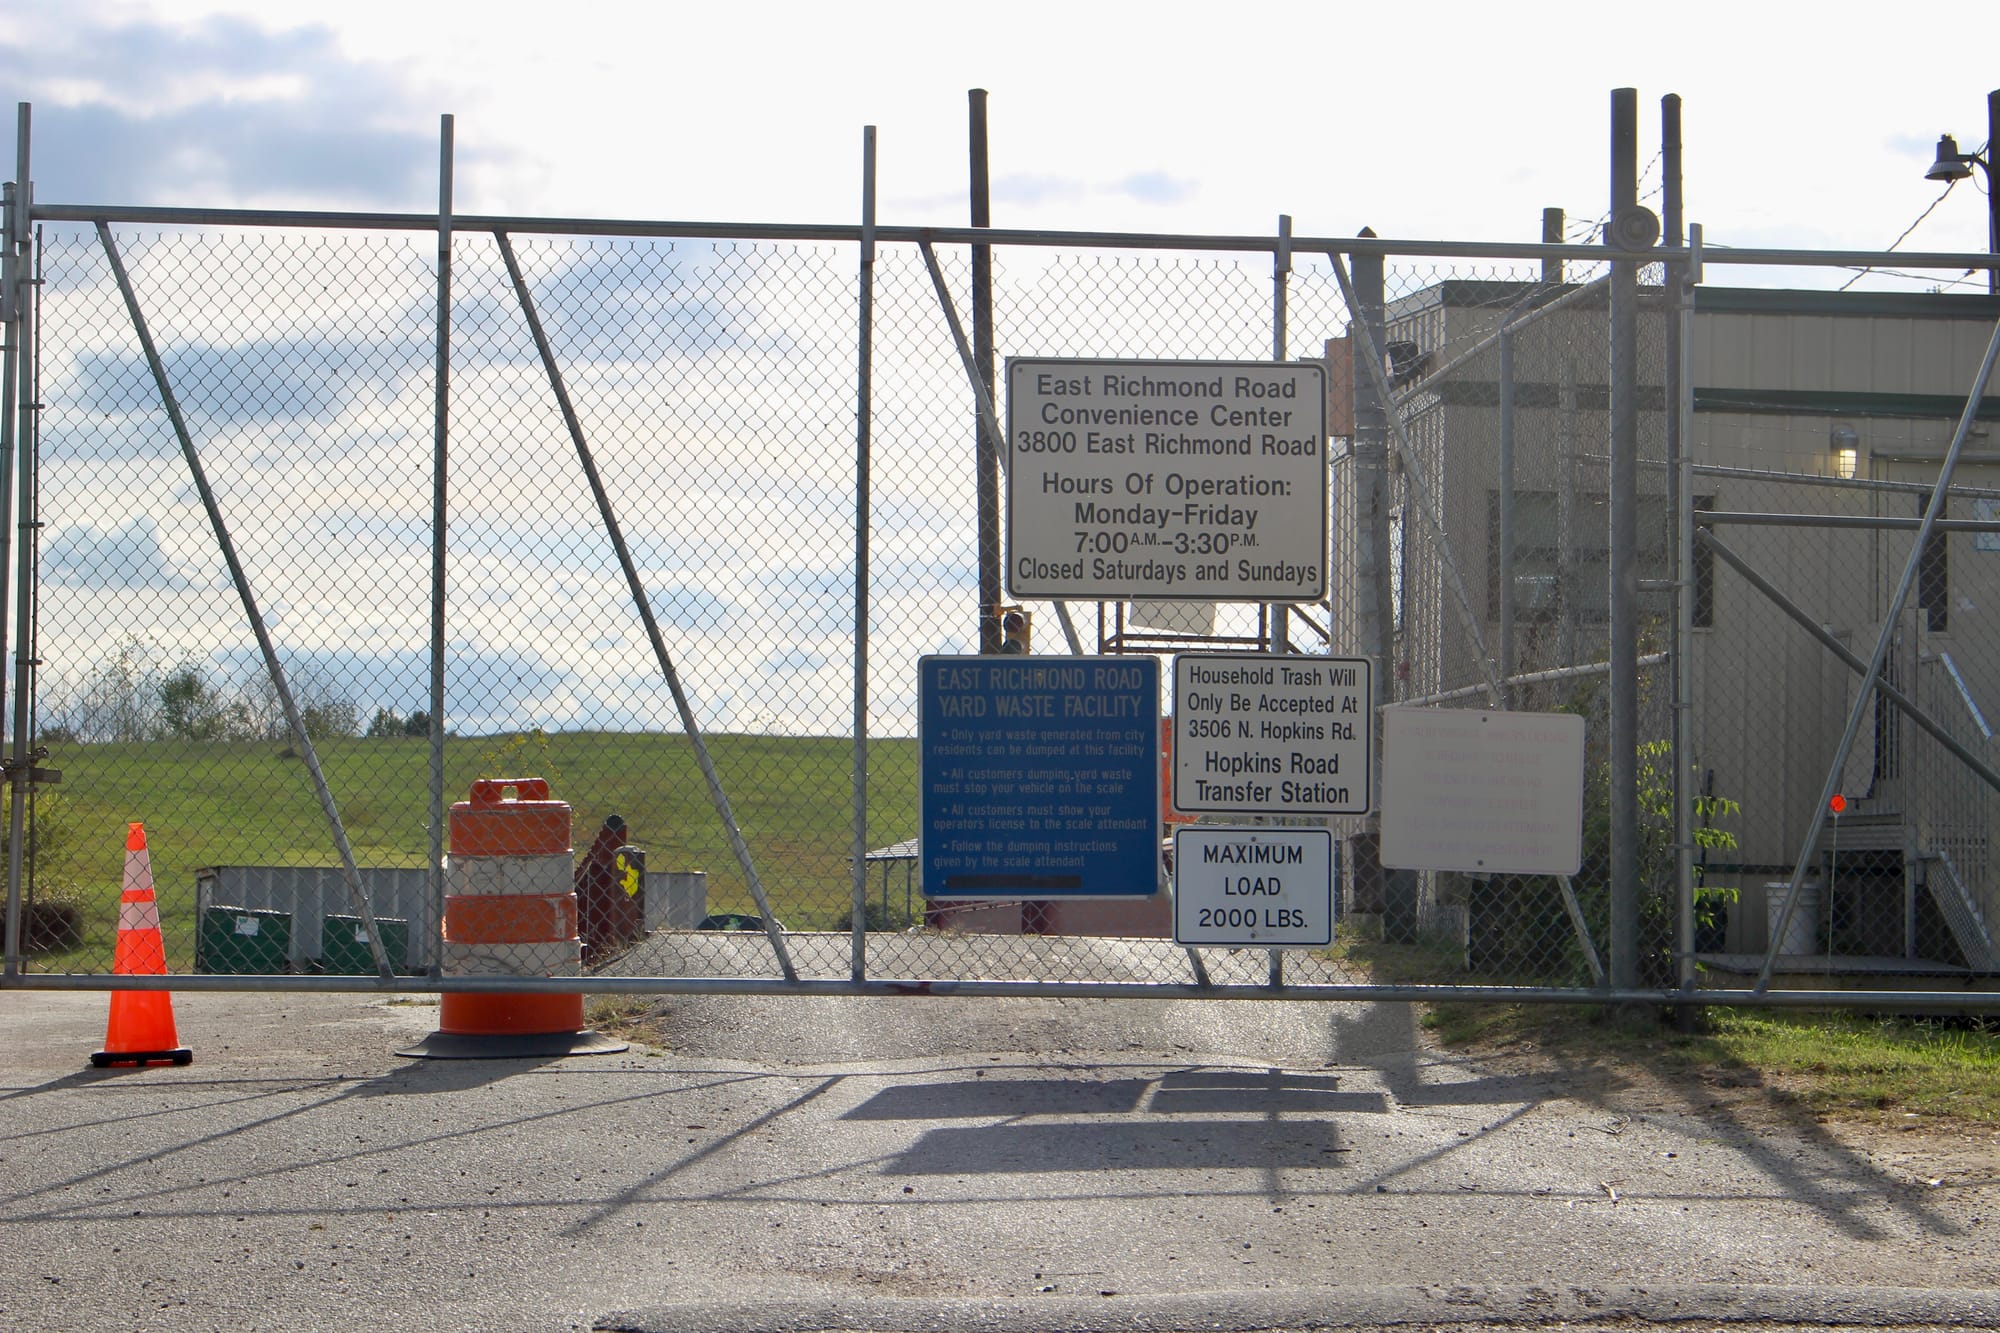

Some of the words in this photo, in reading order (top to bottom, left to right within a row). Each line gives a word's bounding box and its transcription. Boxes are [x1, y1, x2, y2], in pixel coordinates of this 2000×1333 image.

[1037, 374, 1091, 396] East
[1103, 375, 1223, 397] Richmond
[1234, 377, 1296, 398] Road
[1041, 403, 1199, 426] Convenience
[1211, 405, 1293, 427] Center
[1018, 432, 1077, 453] 3800
[1087, 433, 1135, 454] East
[1145, 433, 1251, 455] Richmond
[1261, 435, 1316, 456] Road
[1042, 472, 1113, 494] Hours
[1125, 473, 1153, 495] Of
[1166, 474, 1291, 499] Operation:
[1019, 557, 1083, 580] Closed
[1093, 559, 1186, 584] Saturdays
[1195, 560, 1229, 582] and
[1238, 561, 1317, 586] Sundays
[937, 668, 982, 689] EAST
[990, 668, 1085, 689] RICHMOND
[1094, 668, 1142, 689] ROAD
[1190, 666, 1273, 685] Household
[1281, 668, 1322, 686] Trash
[1329, 668, 1355, 687] Will
[938, 696, 986, 717] YARD
[996, 696, 1054, 717] WASTE
[1064, 696, 1142, 717] FACILITY
[1188, 692, 1223, 714] Only
[1231, 694, 1250, 711] Be
[1258, 694, 1334, 715] Accepted
[1342, 696, 1357, 713] At
[951, 729, 974, 742] Only
[978, 729, 1002, 742] yard
[1006, 730, 1036, 740] waste
[1041, 729, 1092, 742] generated
[1096, 729, 1121, 740] from
[1124, 729, 1145, 742] city
[1189, 720, 1231, 738] 3506
[1238, 721, 1253, 738] N.
[1261, 721, 1324, 742] Hopkins
[1332, 722, 1356, 740] Rd.
[933, 744, 982, 755] residents
[987, 746, 1005, 755] can
[1009, 744, 1021, 755] be
[1025, 744, 1065, 757] dumped
[1069, 745, 1080, 755] at
[1085, 744, 1104, 755] this
[1108, 744, 1145, 757] facility
[1205, 751, 1281, 776] Hopkins
[1291, 753, 1339, 774] Road
[951, 768, 964, 780] All
[968, 770, 1023, 780] customers
[1027, 768, 1070, 783] dumping
[1074, 768, 1097, 783] yard
[1101, 771, 1132, 780] waste
[933, 783, 960, 793] must
[964, 783, 987, 795] stop
[991, 784, 1014, 795] your
[1019, 782, 1054, 793] vehicle
[1059, 785, 1071, 793] on
[1075, 782, 1092, 793] the
[1096, 782, 1123, 793] scale
[1195, 780, 1272, 802] Transfer
[1281, 781, 1349, 804] Station
[951, 805, 964, 816] All
[968, 806, 1023, 816] customers
[1027, 806, 1054, 816] must
[1058, 805, 1084, 816] show
[1088, 806, 1111, 818] your
[988, 819, 1025, 829] license
[1029, 819, 1040, 829] to
[1044, 819, 1060, 829] the
[1065, 819, 1093, 829] scale
[1097, 819, 1147, 830] attendant
[951, 841, 982, 852] Follow
[986, 841, 1003, 852] the
[1007, 841, 1050, 854] dumping
[1055, 841, 1117, 852] instructions
[1203, 845, 1302, 864] MAXIMUM
[933, 856, 960, 869] given
[965, 856, 977, 869] by
[982, 856, 999, 866] the
[1003, 856, 1031, 866] scale
[1034, 856, 1085, 866] attendant
[1225, 877, 1281, 895] LOAD
[1200, 909, 1257, 927] 2000
[1265, 910, 1308, 928] LBS.
